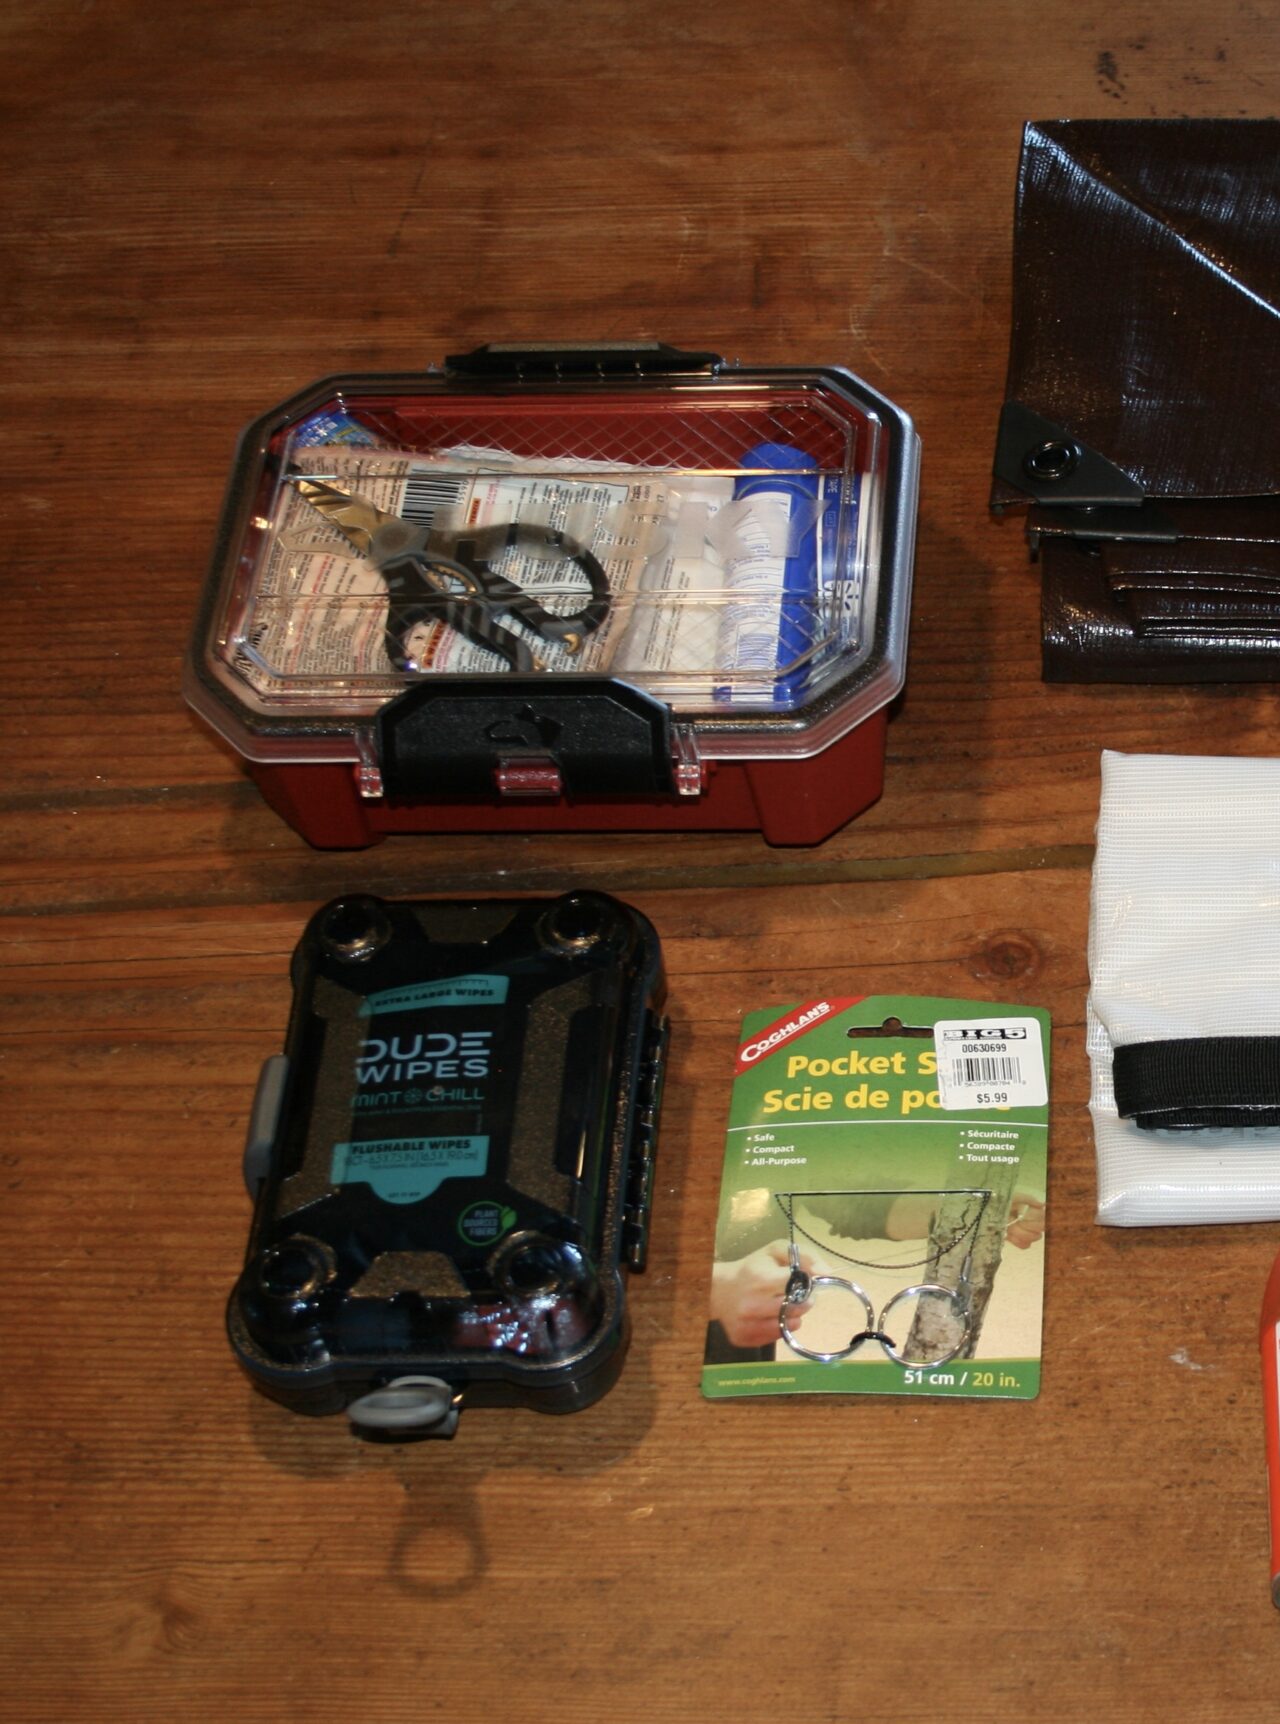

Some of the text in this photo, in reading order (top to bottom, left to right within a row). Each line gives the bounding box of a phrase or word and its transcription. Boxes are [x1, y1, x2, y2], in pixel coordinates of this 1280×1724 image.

[455, 989, 494, 997] WIPES
[740, 1001, 830, 1062] COGHLAN'S
[354, 1031, 493, 1065] DUDE
[962, 1043, 1007, 1053] 00630699
[787, 1050, 907, 1078] Pocket
[354, 1058, 489, 1085] WIPES
[425, 1085, 486, 1101] CHILL
[763, 1086, 833, 1113] Scie
[845, 1083, 890, 1109] de
[976, 1092, 1008, 1103] $5.99
[754, 1133, 775, 1142] Safe
[967, 1129, 1019, 1139] Sécuritaire
[352, 1139, 471, 1154] FLUSHABLE WIPES
[753, 1145, 795, 1154] Compact
[967, 1142, 1015, 1151] Compacte
[752, 1157, 807, 1166] All-Purpose
[966, 1153, 1020, 1164] Tout usage
[717, 1375, 796, 1387] www.coghlans.com
[904, 1370, 923, 1384] 51
[929, 1374, 955, 1385] cm
[972, 1372, 994, 1386] 20
[999, 1372, 1021, 1388] in.
